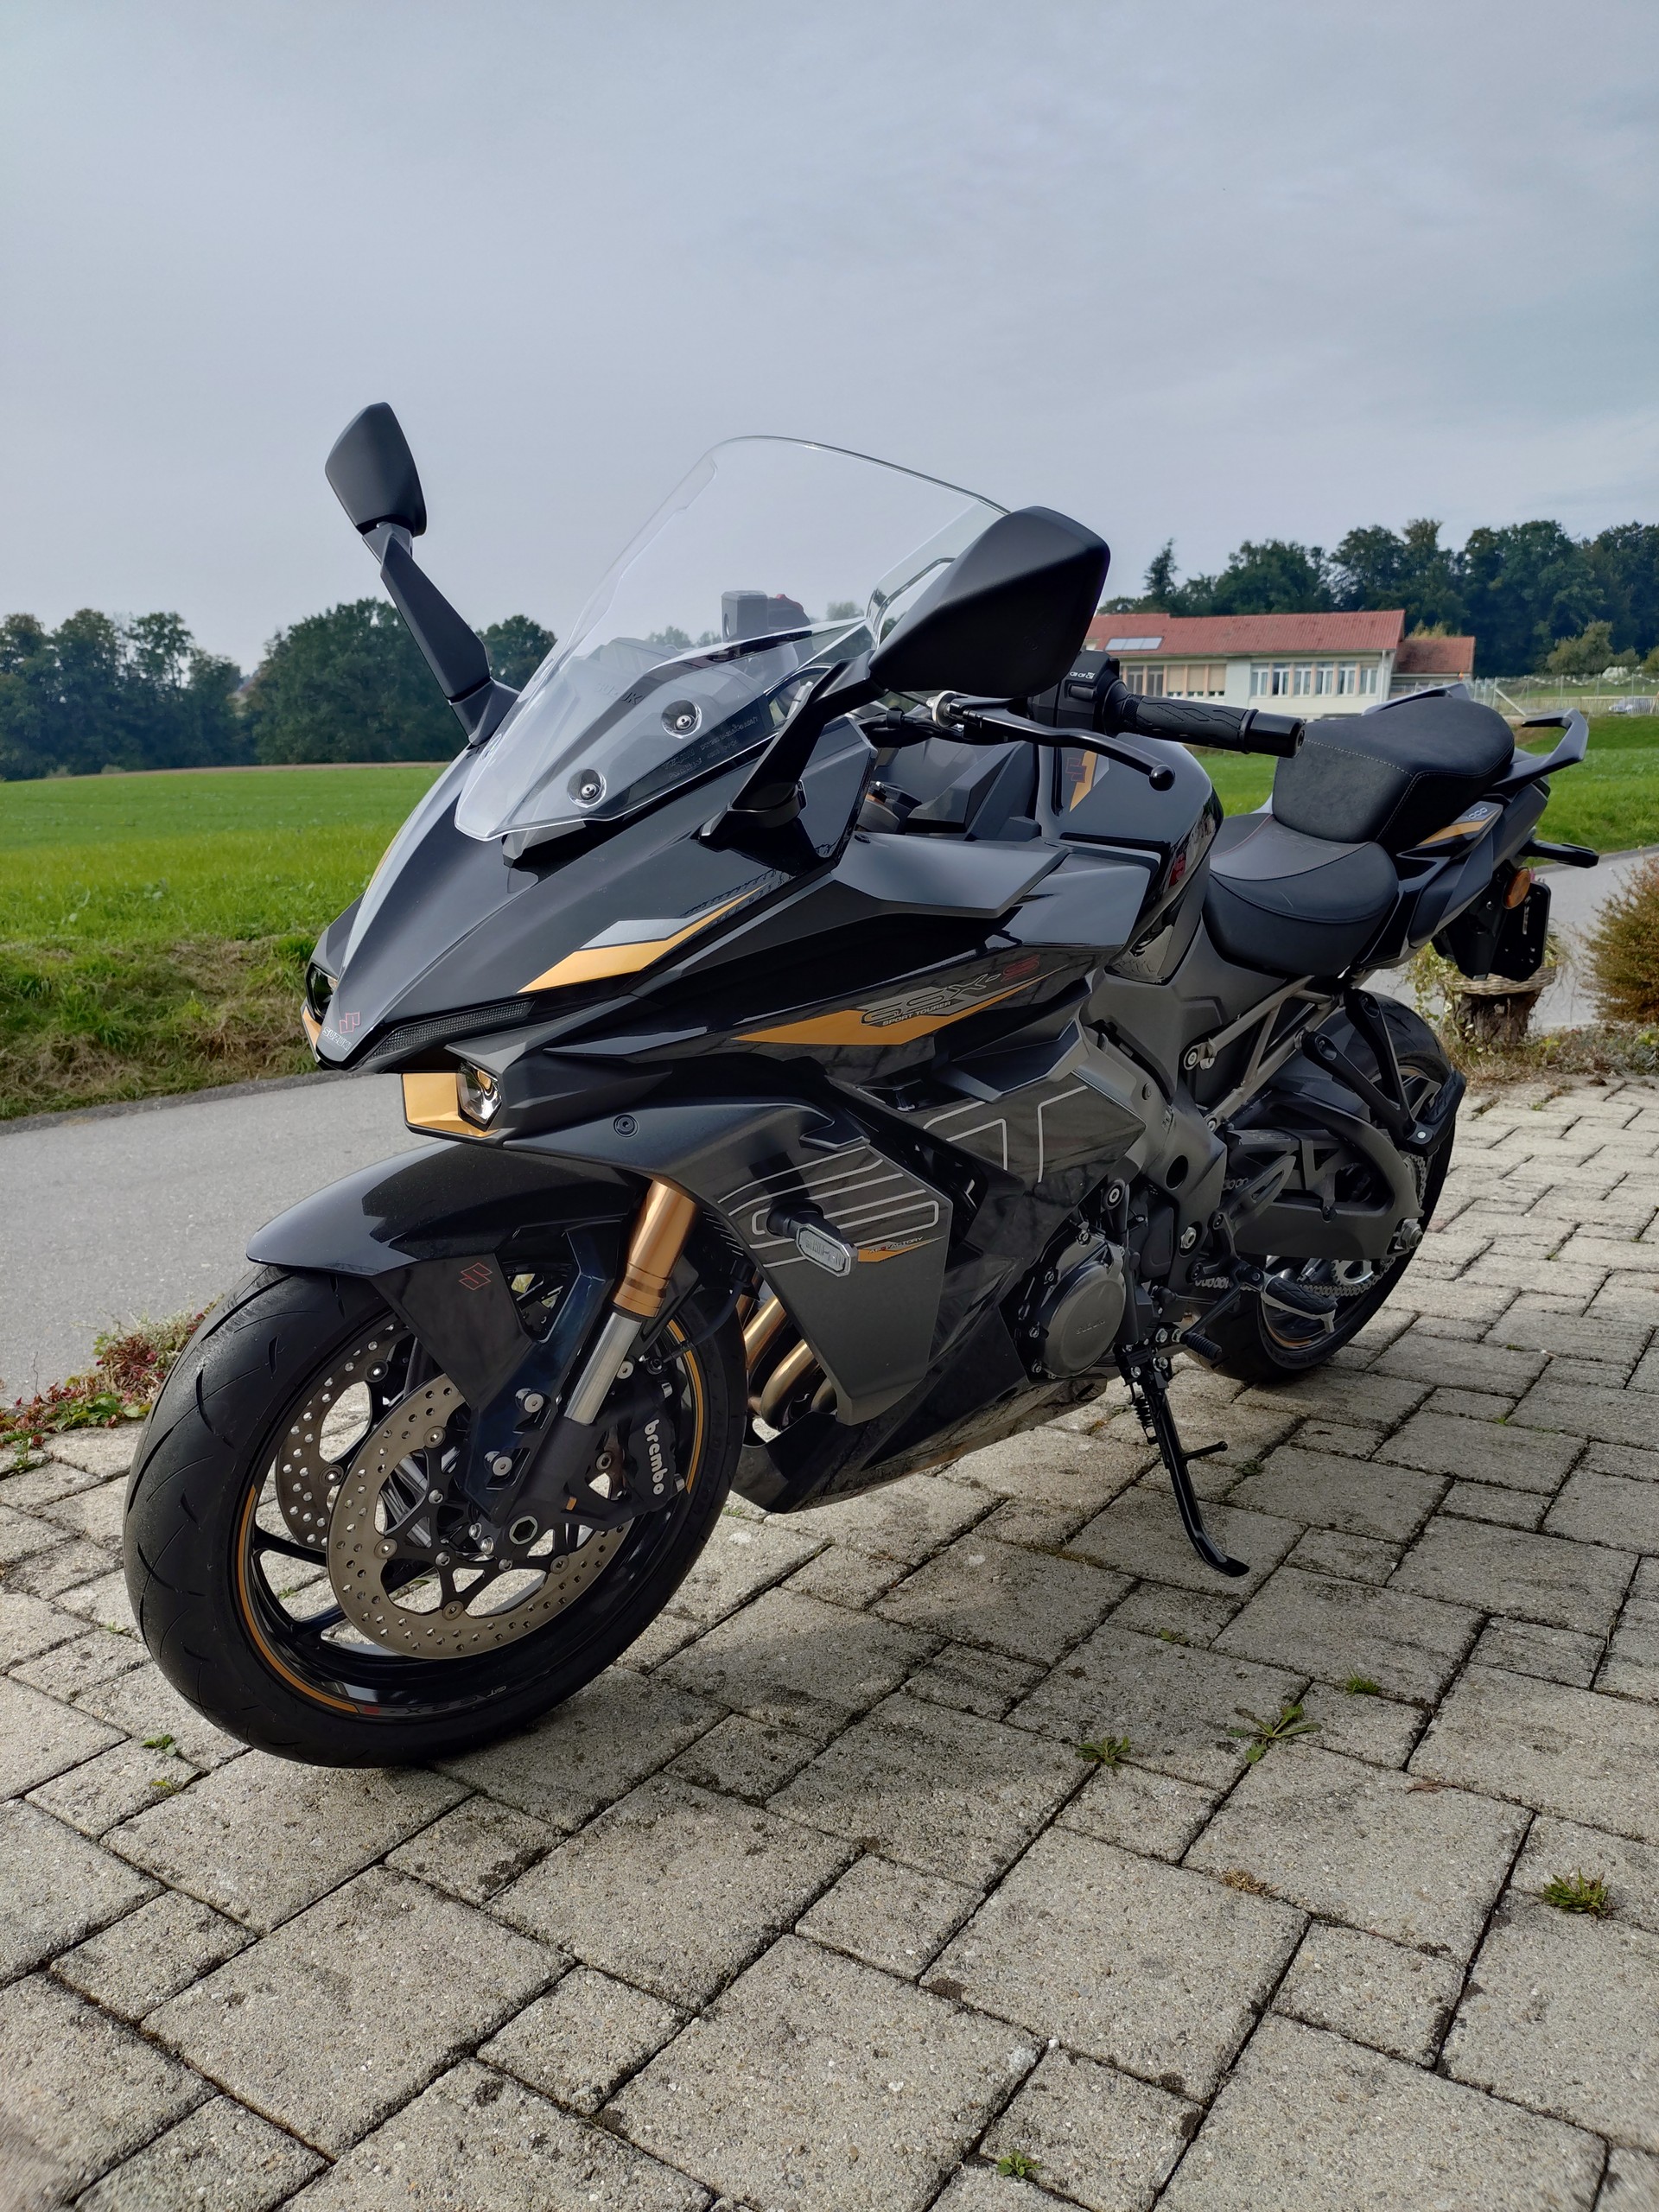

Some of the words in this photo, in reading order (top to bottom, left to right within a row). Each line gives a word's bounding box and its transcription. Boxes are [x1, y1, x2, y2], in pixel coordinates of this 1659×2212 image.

[1465, 807, 1487, 820] 1000
[881, 1010, 913, 1027] SPORT
[916, 1001, 952, 1016] TOURER
[322, 1027, 352, 1052] SUZUKI
[645, 1419, 668, 1495] brembo
